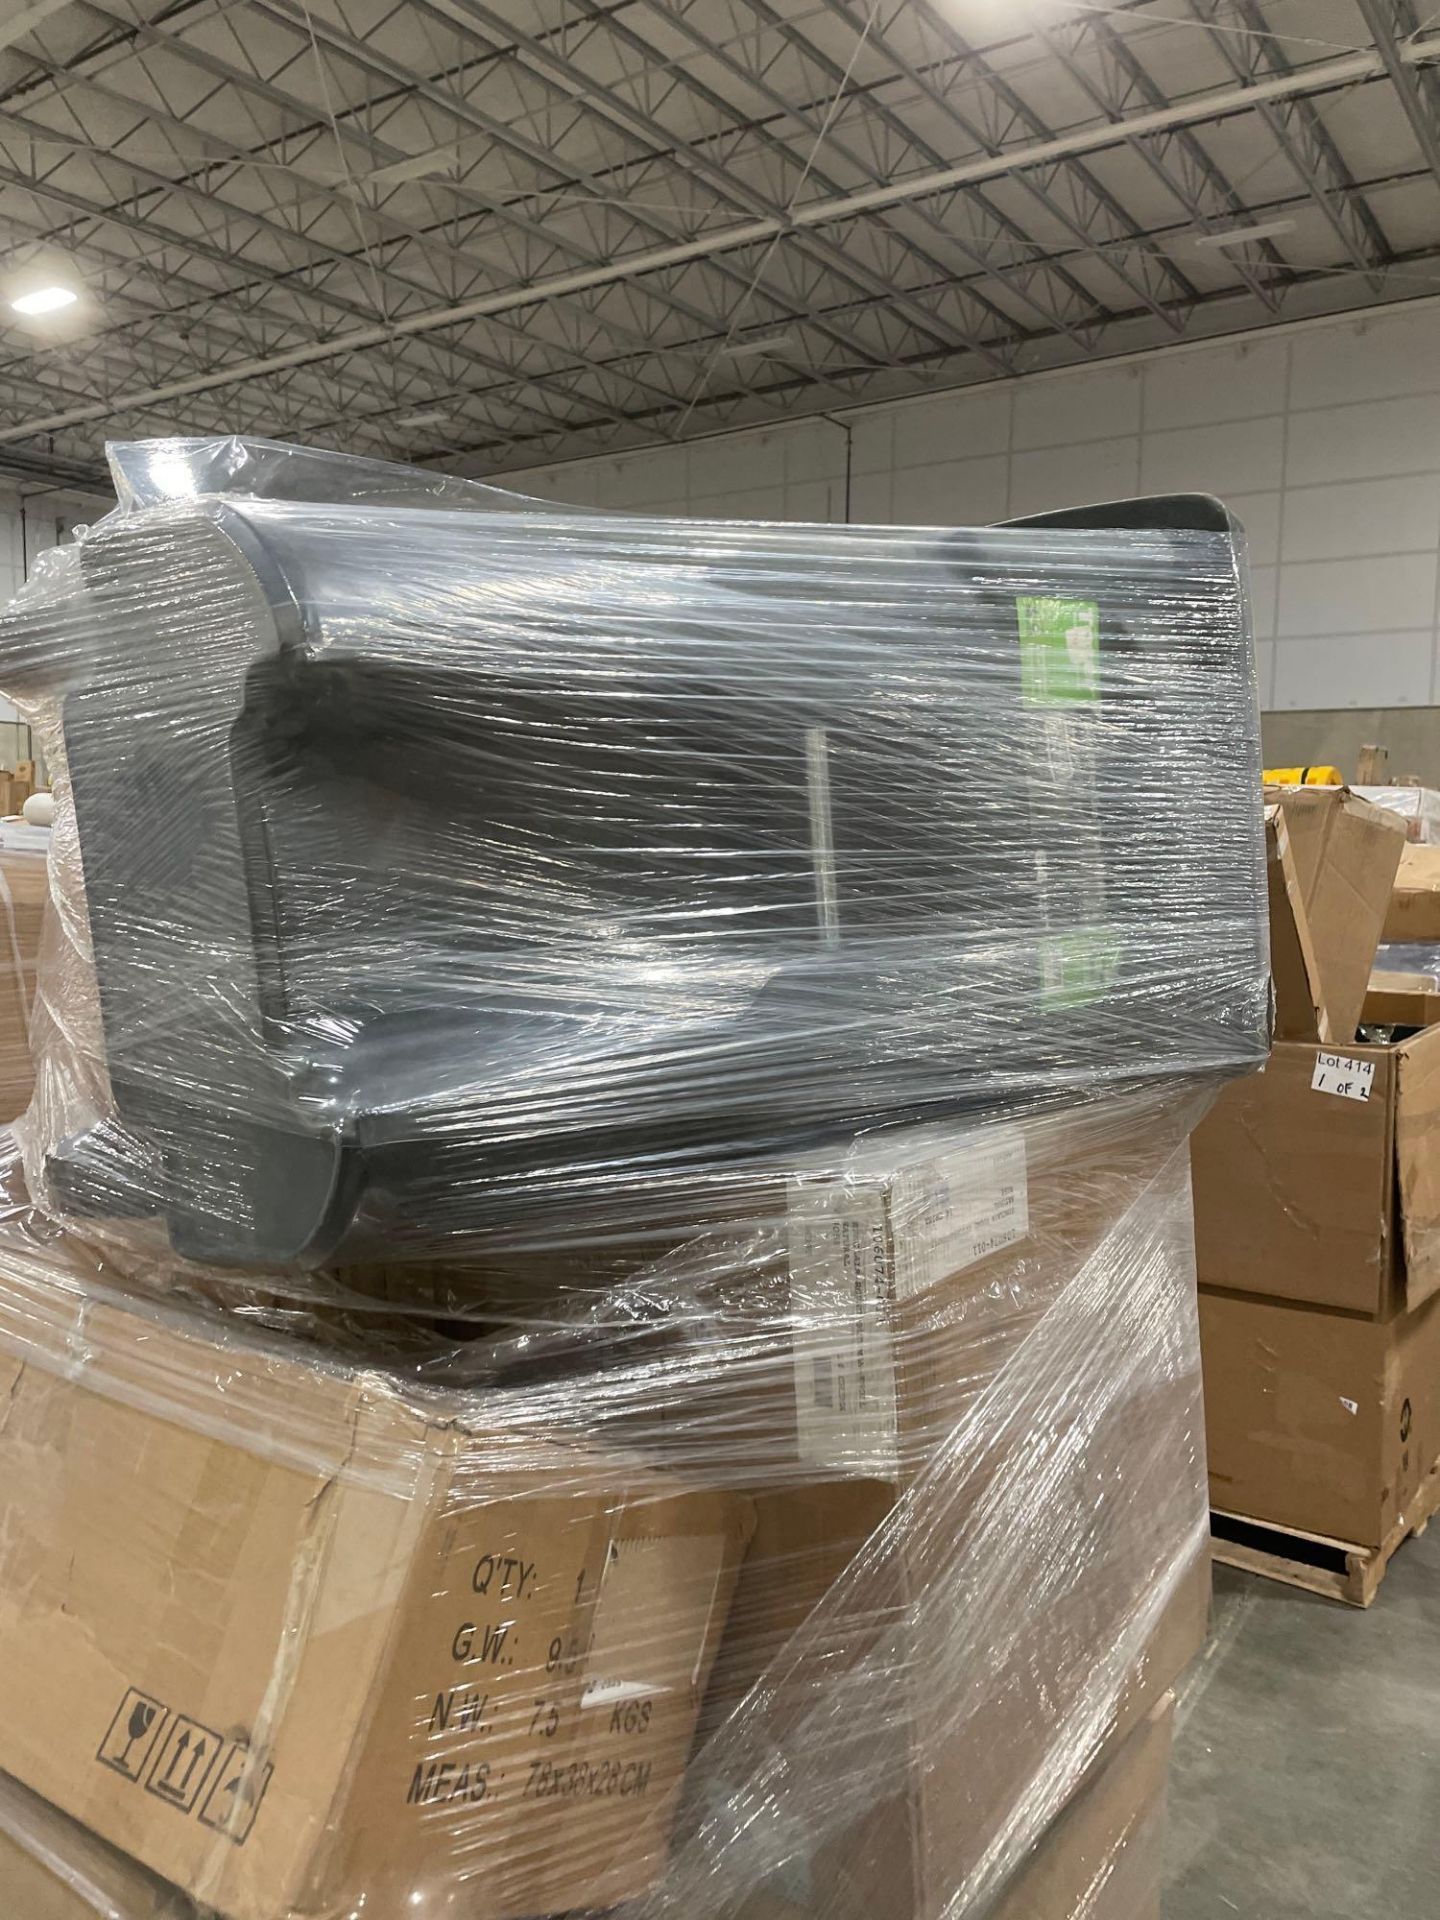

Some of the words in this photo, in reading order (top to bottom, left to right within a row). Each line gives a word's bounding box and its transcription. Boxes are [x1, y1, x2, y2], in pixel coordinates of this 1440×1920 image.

[1318, 1073, 1326, 1087] 1
[1336, 1081, 1354, 1095] OF
[1359, 1087, 1369, 1099] 2
[1344, 1060, 1372, 1075] 414
[872, 1225, 887, 1325] 106074-1
[472, 1554, 538, 1600] Q'TY:
[574, 1569, 586, 1604] 1
[452, 1622, 519, 1666] G.W.:
[428, 1692, 499, 1734] N.W.:
[609, 1700, 653, 1734] KGS
[406, 1761, 507, 1805] MEAS.:
